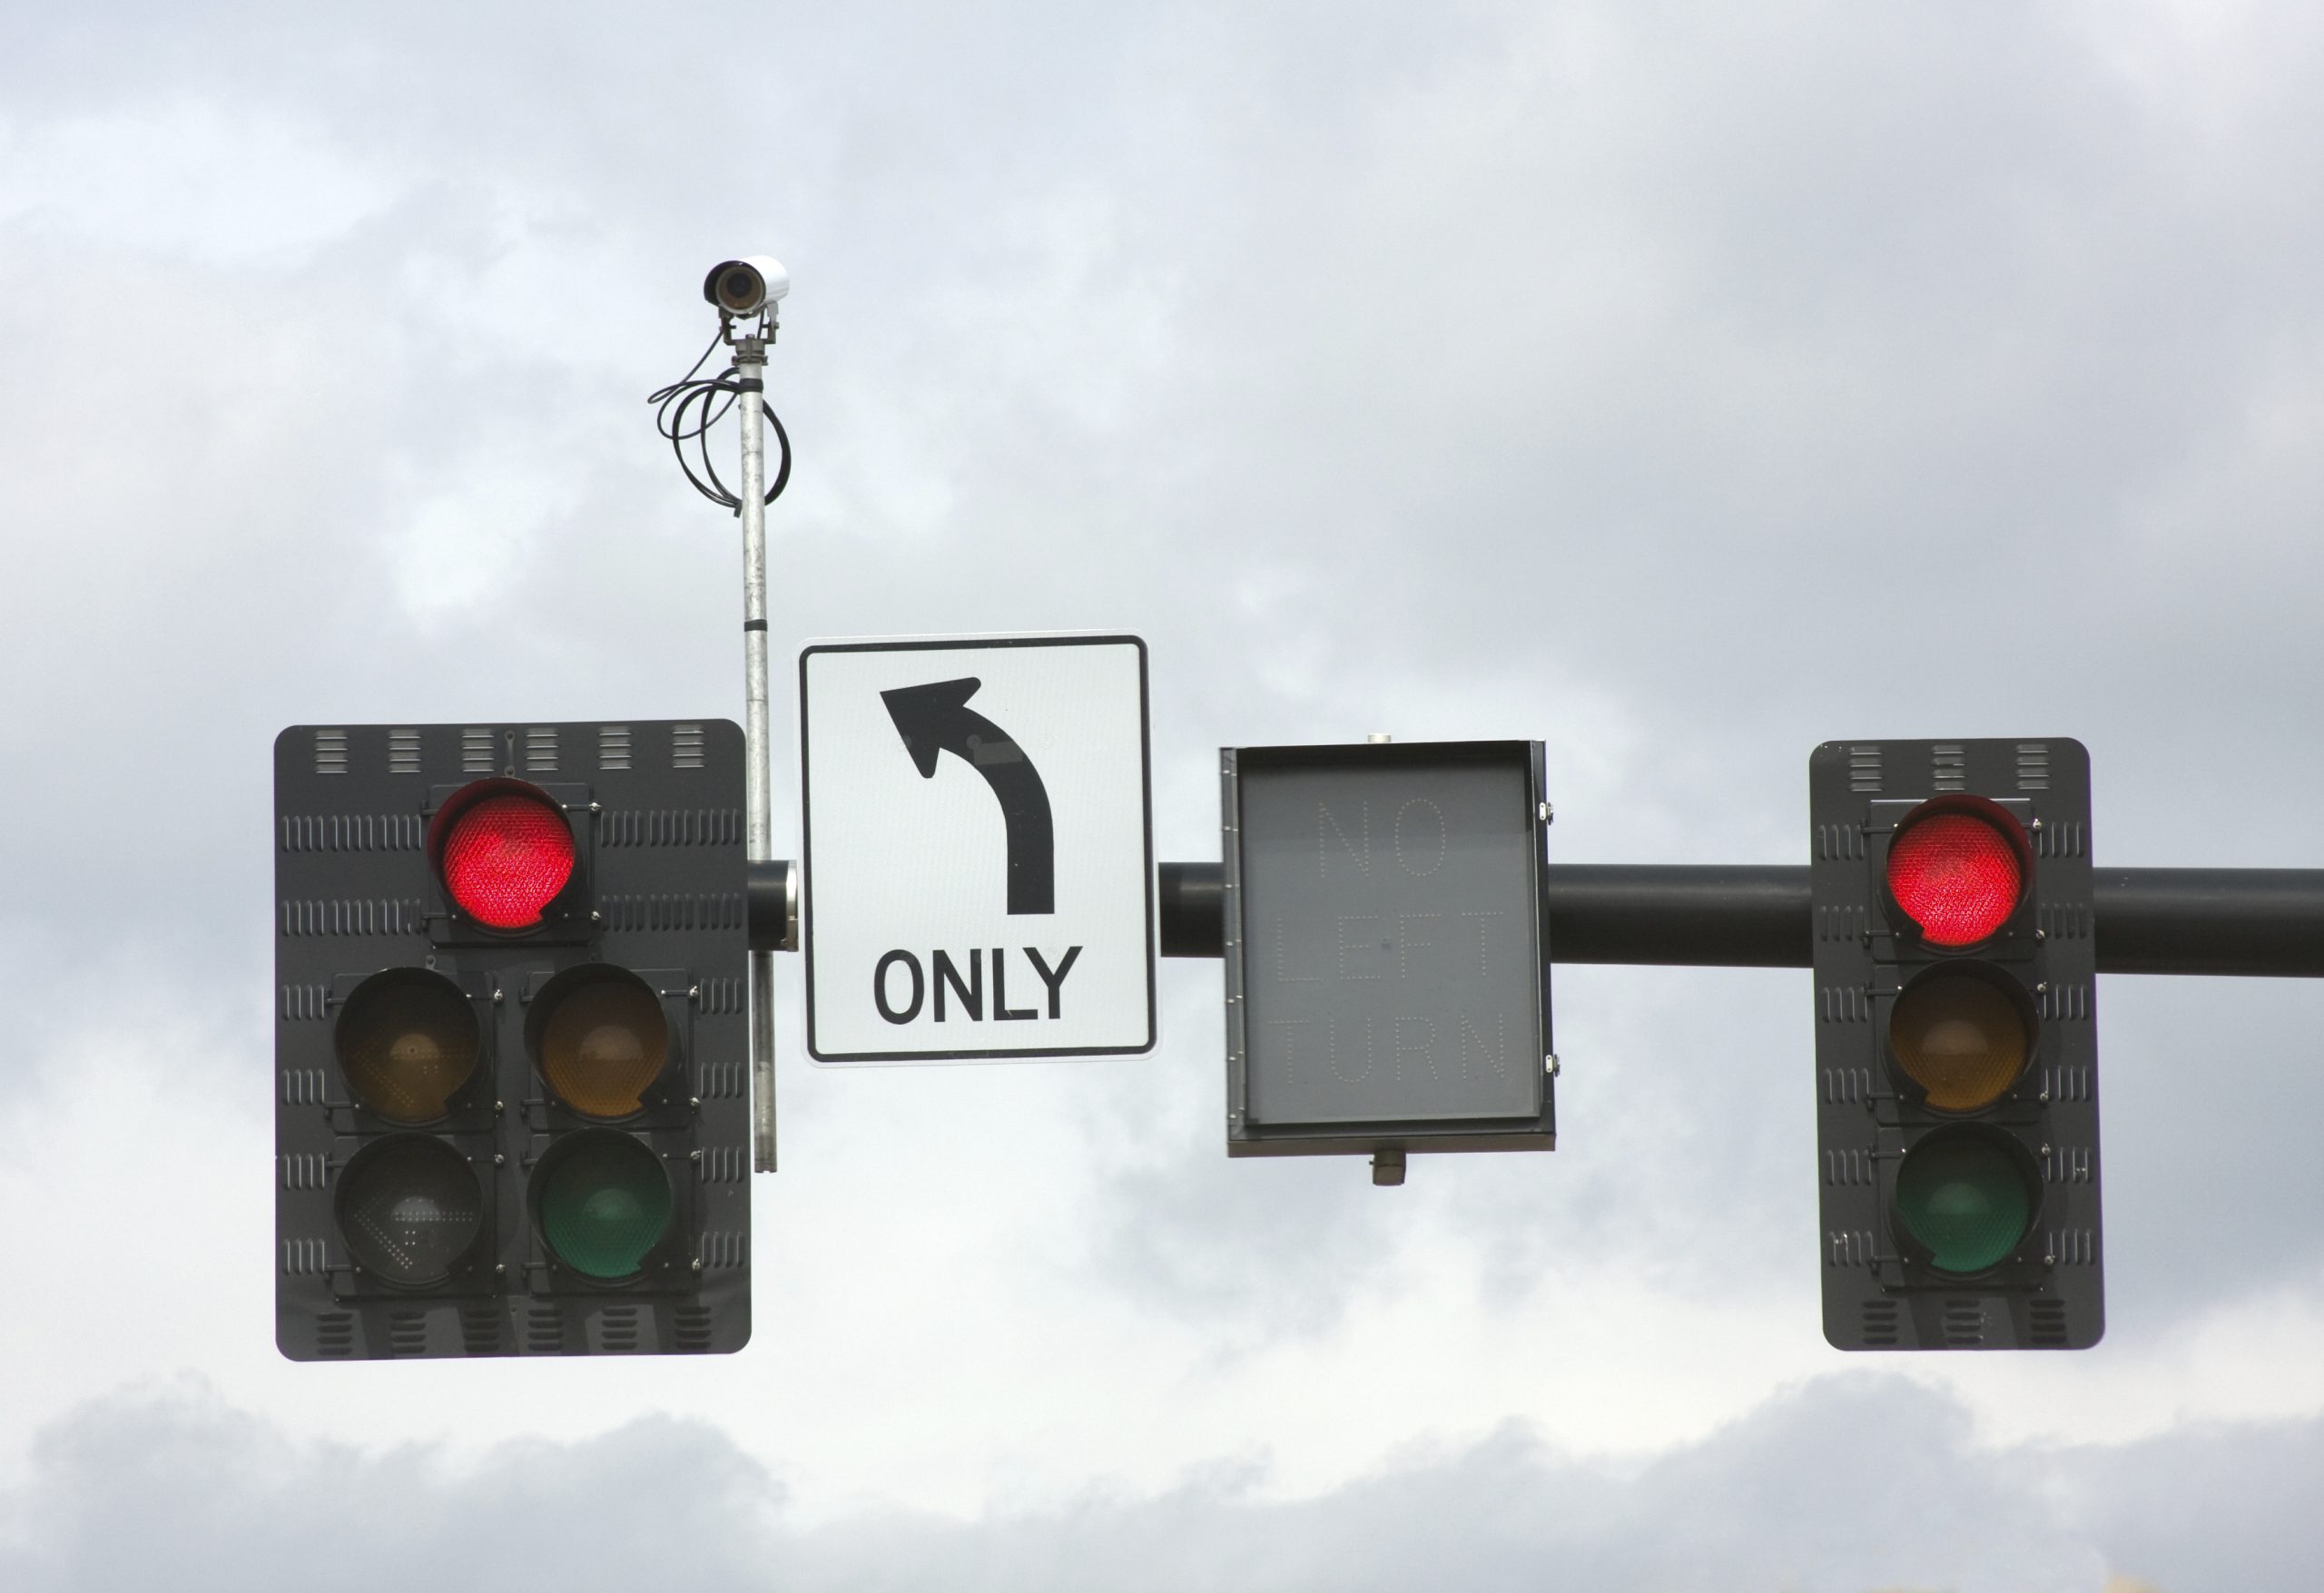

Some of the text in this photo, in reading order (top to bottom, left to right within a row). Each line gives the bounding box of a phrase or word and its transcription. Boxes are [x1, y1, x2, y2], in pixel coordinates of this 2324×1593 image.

[1317, 797, 1447, 879] NO
[1275, 910, 1505, 983] LEFT
[874, 946, 1082, 1025] ONLY
[1265, 1012, 1506, 1087] TURN
